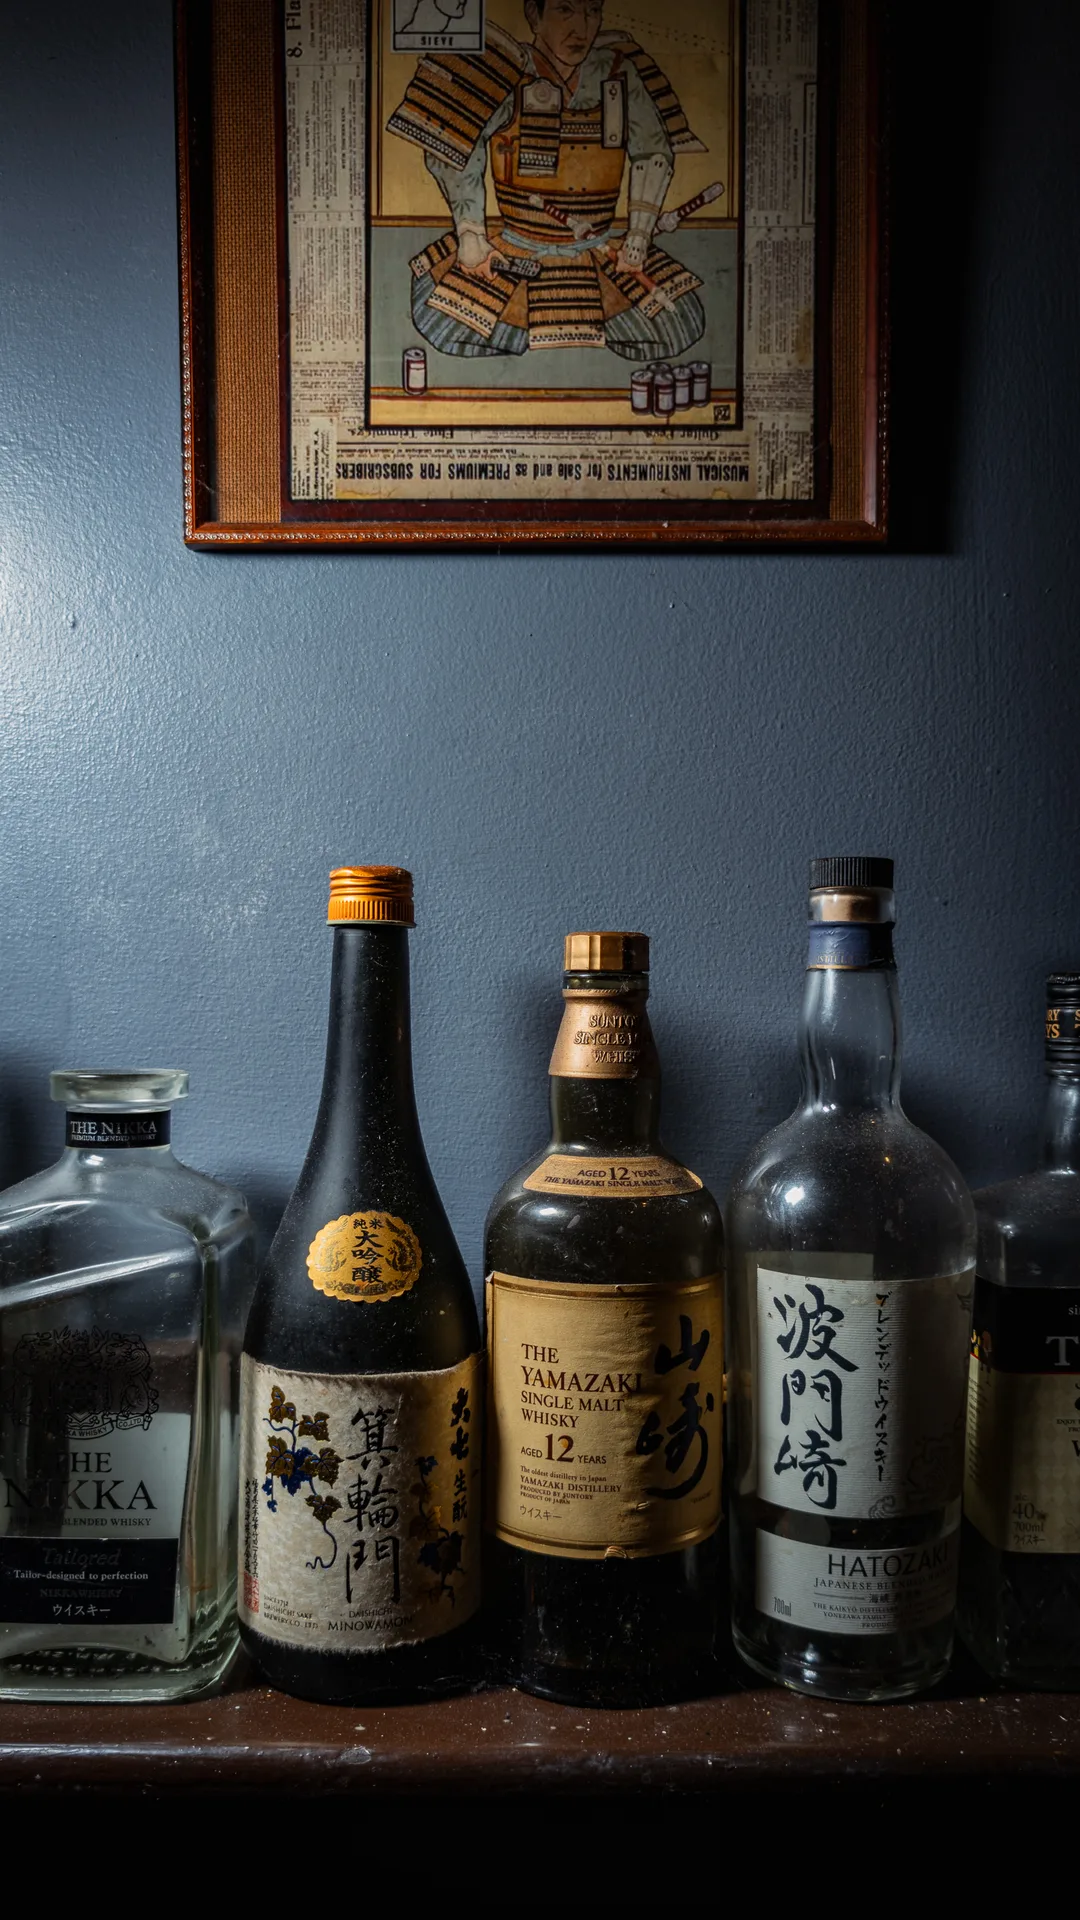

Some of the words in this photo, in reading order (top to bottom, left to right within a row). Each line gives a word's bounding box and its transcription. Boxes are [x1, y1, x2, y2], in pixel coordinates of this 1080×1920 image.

[286, 41, 303, 58] 8.
[420, 36, 454, 47] SIEVE
[336, 463, 413, 480] SUBSCRIBERS
[420, 463, 441, 480] FOR
[448, 463, 510, 480] PREMIUMS
[515, 463, 527, 476] as
[533, 463, 553, 480] and
[558, 463, 581, 480] Sale
[586, 464, 601, 480] for
[607, 464, 691, 481] INSTRUMENTS
[696, 464, 749, 482] MUSICAL
[573, 1031, 625, 1046] SINGLE
[70, 1120, 98, 1135] THE
[101, 1120, 158, 1135] NIKKA
[71, 1133, 96, 1141] PREMIUM
[97, 1134, 130, 1142] BLENDED
[544, 1175, 561, 1184] THE
[562, 1178, 605, 1187] YAMAZAKI
[577, 1169, 607, 1178] AGED
[609, 1167, 631, 1180] 12
[631, 1169, 660, 1178] YEARS
[353, 1218, 384, 1230] 純米
[521, 1343, 559, 1364] THE
[521, 1365, 643, 1393] YAMAZAKI
[520, 1390, 574, 1410] SINGLE
[579, 1398, 625, 1411] MALT
[521, 1408, 580, 1428] WHISKY
[82, 1427, 108, 1437] WHISKY
[520, 1446, 543, 1458] AGED
[545, 1433, 575, 1463] 12
[577, 1454, 607, 1464] YEARS
[520, 1465, 530, 1474] The
[531, 1469, 548, 1477] oldest
[549, 1470, 577, 1482] distillery
[588, 1475, 607, 1483] Japan
[520, 1475, 564, 1490] YAMAZAKI
[568, 1483, 622, 1493] DISTILLERY
[520, 1484, 551, 1496] PRODUCED
[562, 1492, 593, 1500] SUNTORY
[4, 1479, 158, 1510] NIKKA
[520, 1491, 543, 1501] PRODUCT
[520, 1505, 563, 1520] ウイスキー
[61, 1518, 108, 1526] BLENDED
[111, 1518, 152, 1526] WHISKY
[827, 1541, 949, 1577] HATOZAKI
[13, 1570, 86, 1581] Tailor-designed
[89, 1571, 99, 1580] to
[101, 1571, 149, 1581] perfection
[813, 1577, 872, 1591] JAPANESE
[52, 1604, 111, 1617] ウイスキー
[348, 1607, 393, 1619] DAISHICHI
[773, 1596, 792, 1617] 700ml
[812, 1601, 828, 1611] THE
[829, 1604, 857, 1613] KAIKYO
[327, 1615, 414, 1631] MINOWAMON
[823, 1611, 861, 1620] YONEZAWA
